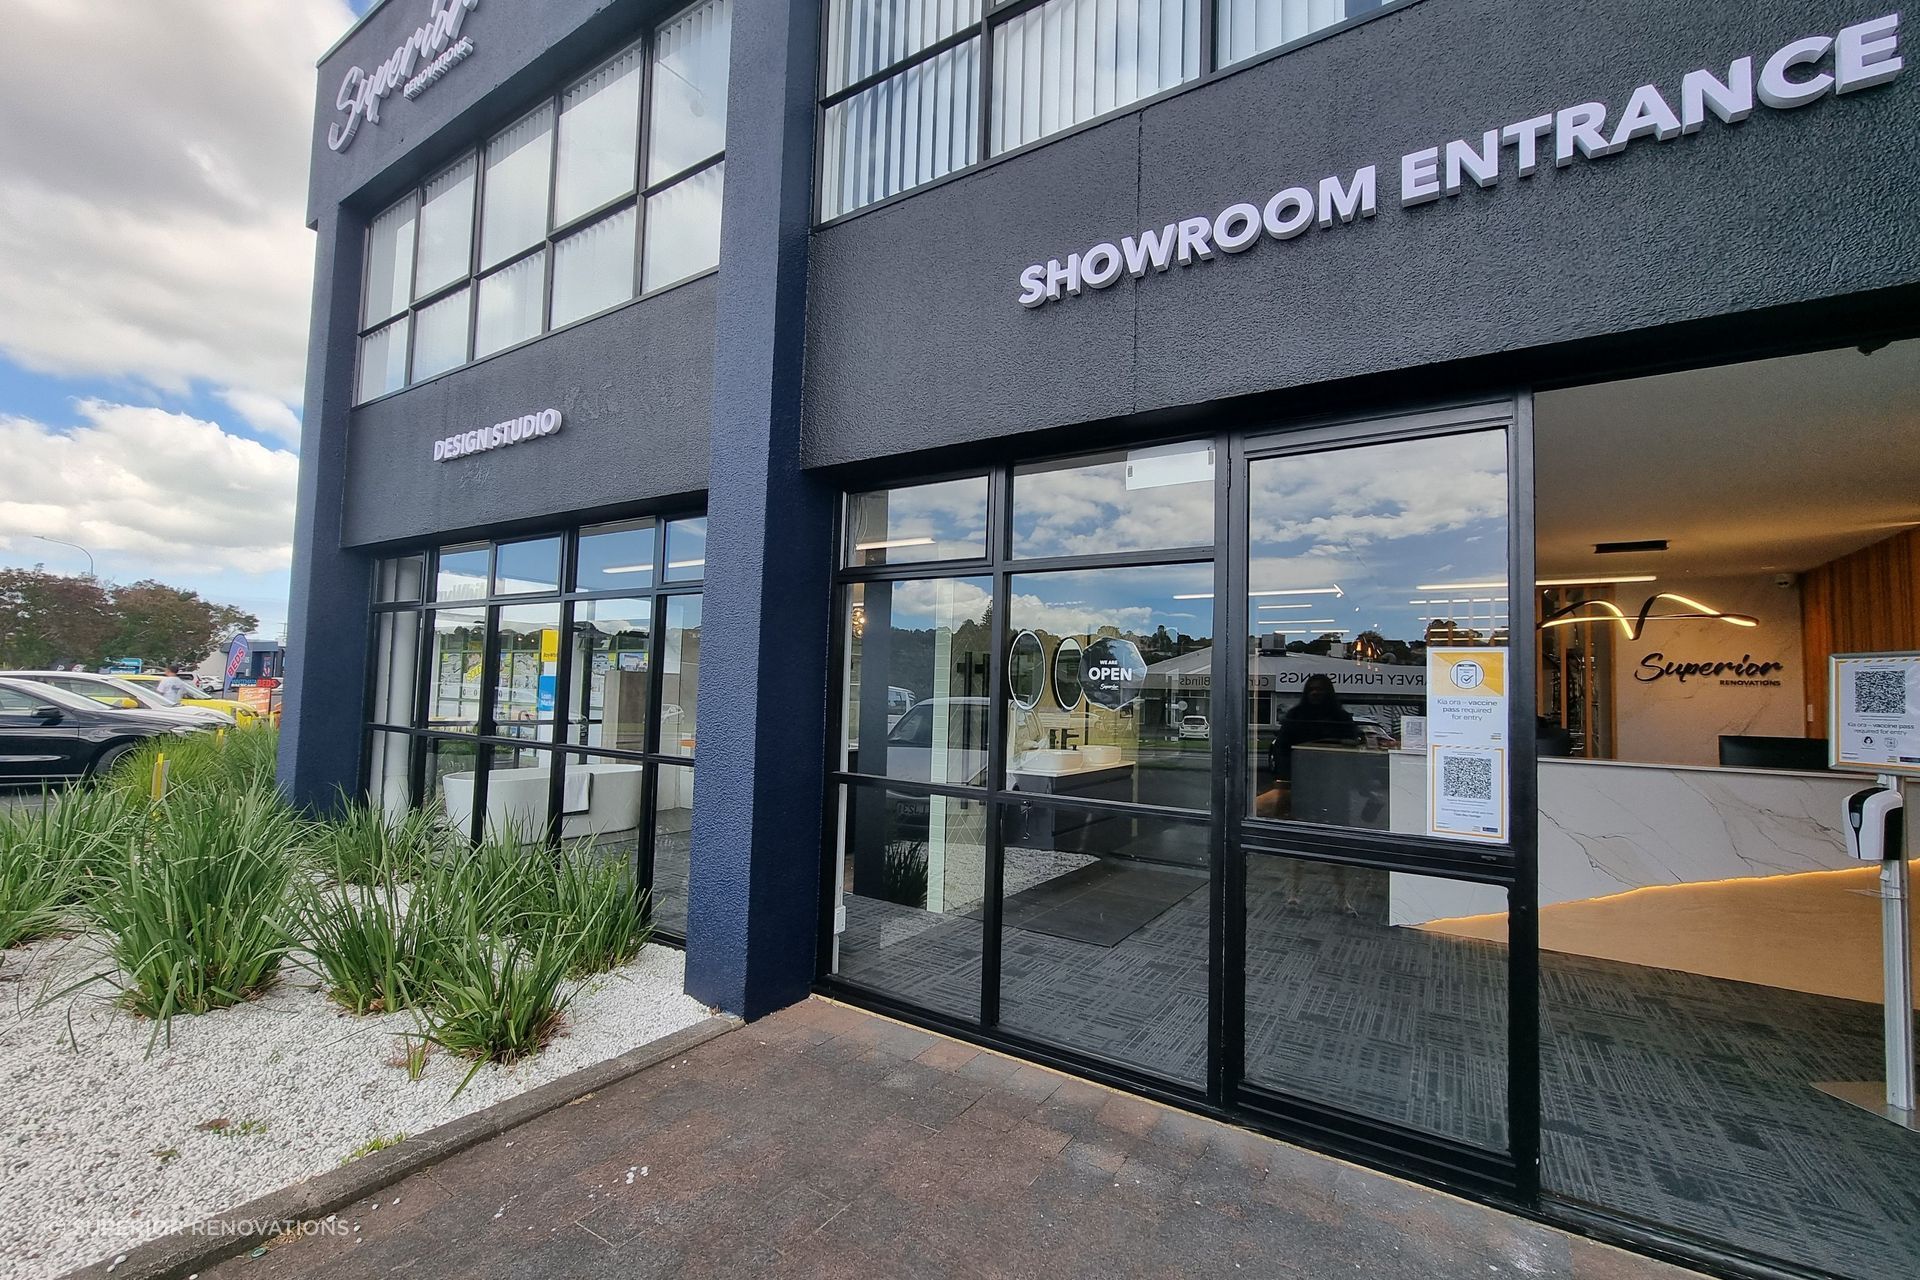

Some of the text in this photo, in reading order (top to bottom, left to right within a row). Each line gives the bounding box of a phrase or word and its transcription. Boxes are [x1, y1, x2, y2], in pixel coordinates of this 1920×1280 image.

[404, 36, 474, 100] RENOVATIONS
[1018, 13, 1902, 308] SHOWROOM ENTRANCE
[433, 408, 562, 462] DESIGN STUDIO
[227, 648, 246, 678] BEDS
[1088, 666, 1132, 681] OPEN
[1634, 653, 1784, 682] Superior
